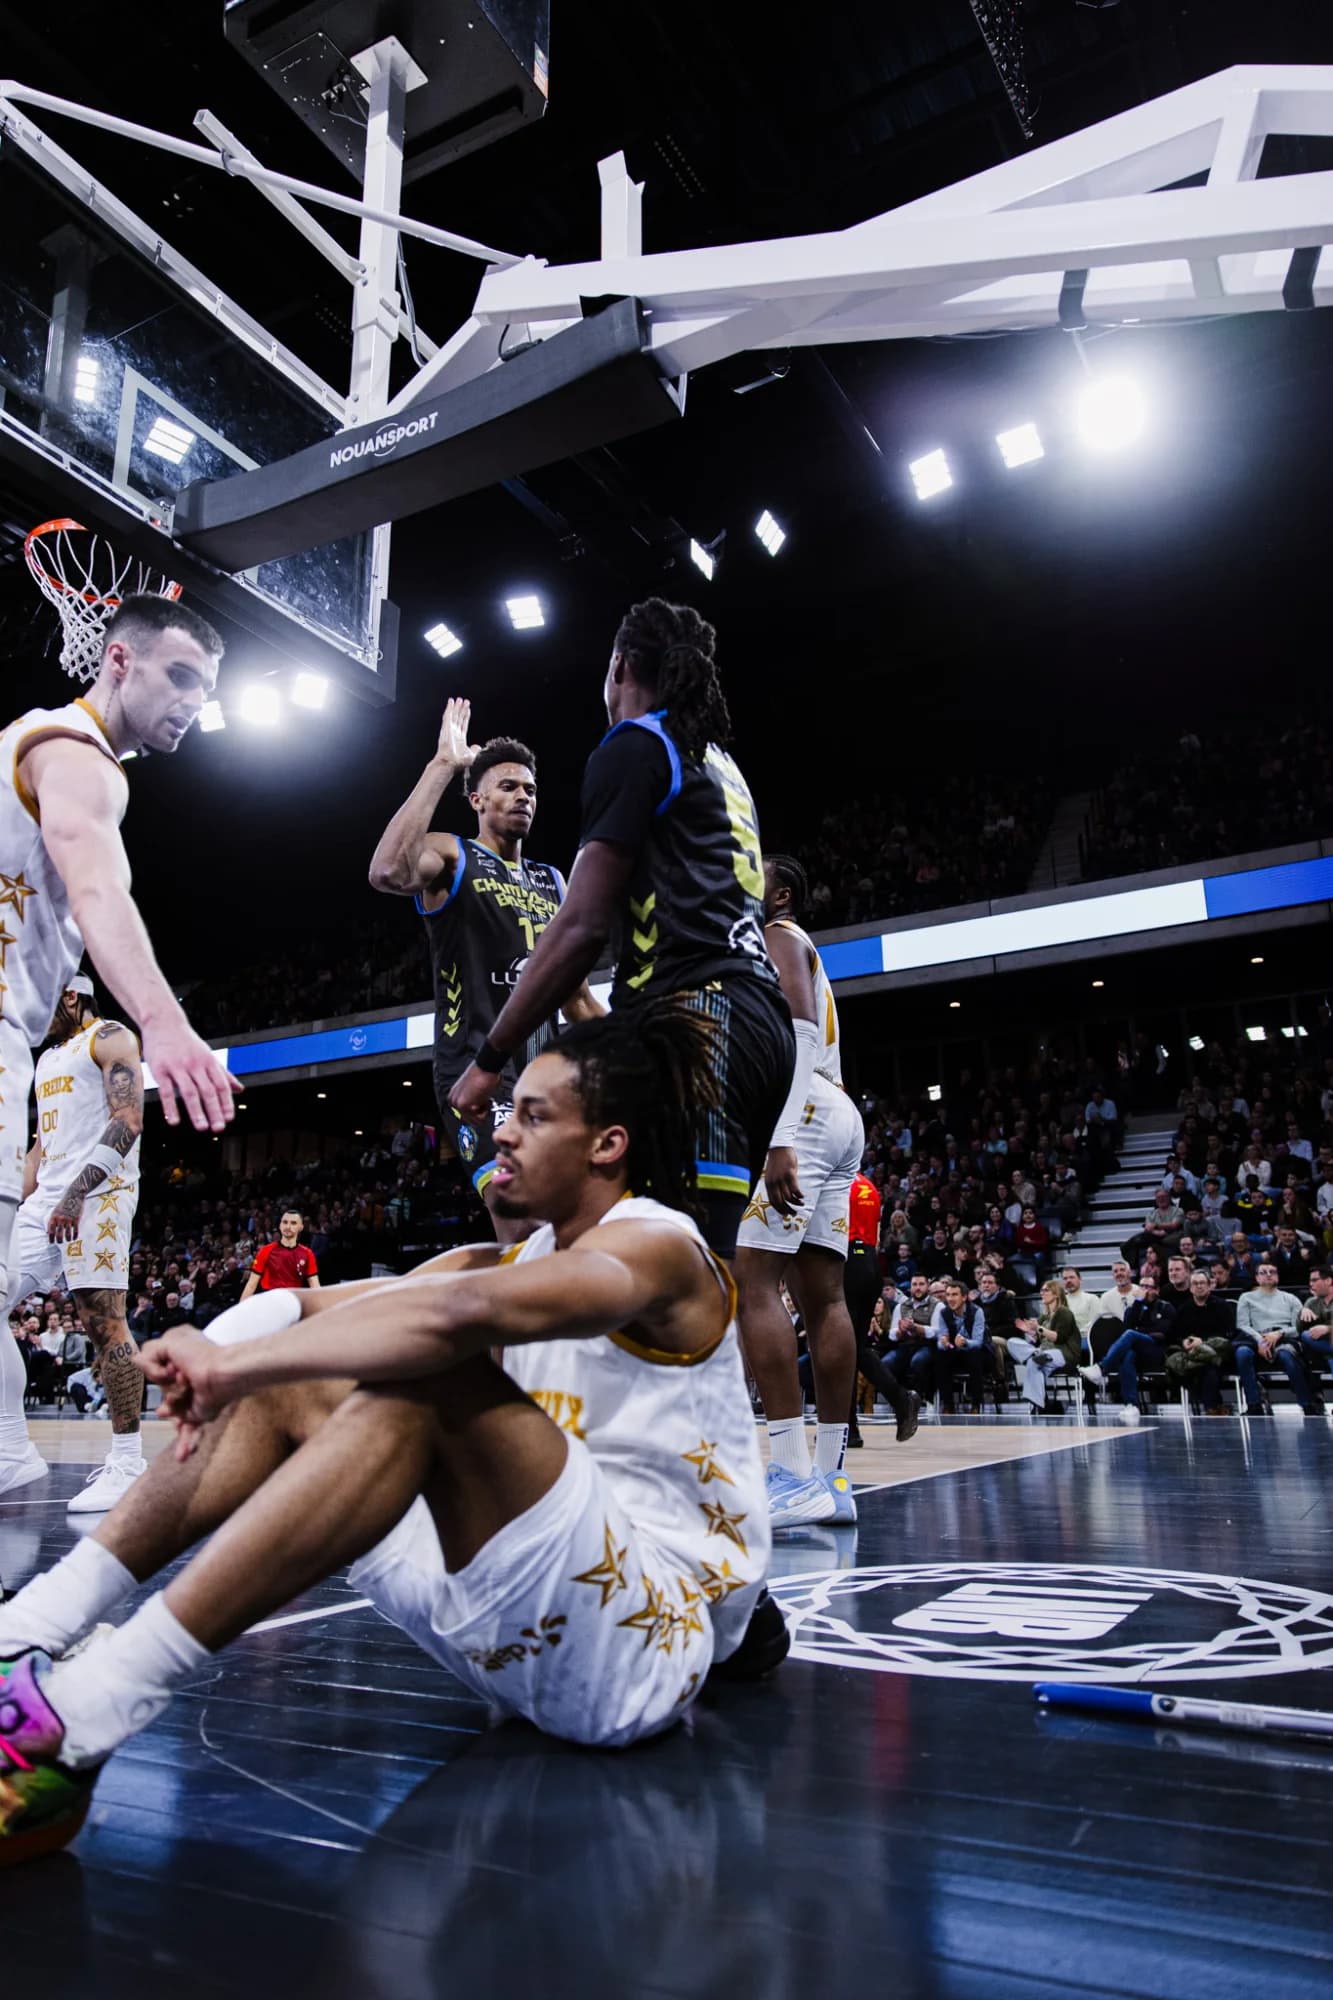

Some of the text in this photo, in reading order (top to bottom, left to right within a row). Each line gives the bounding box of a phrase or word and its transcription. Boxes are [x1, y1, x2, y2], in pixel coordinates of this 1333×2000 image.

[329, 411, 439, 468] NOUANSPORT
[518, 916, 547, 951] 1
[36, 1075, 74, 1099] VREUX
[891, 1582, 1155, 1641] LNB
